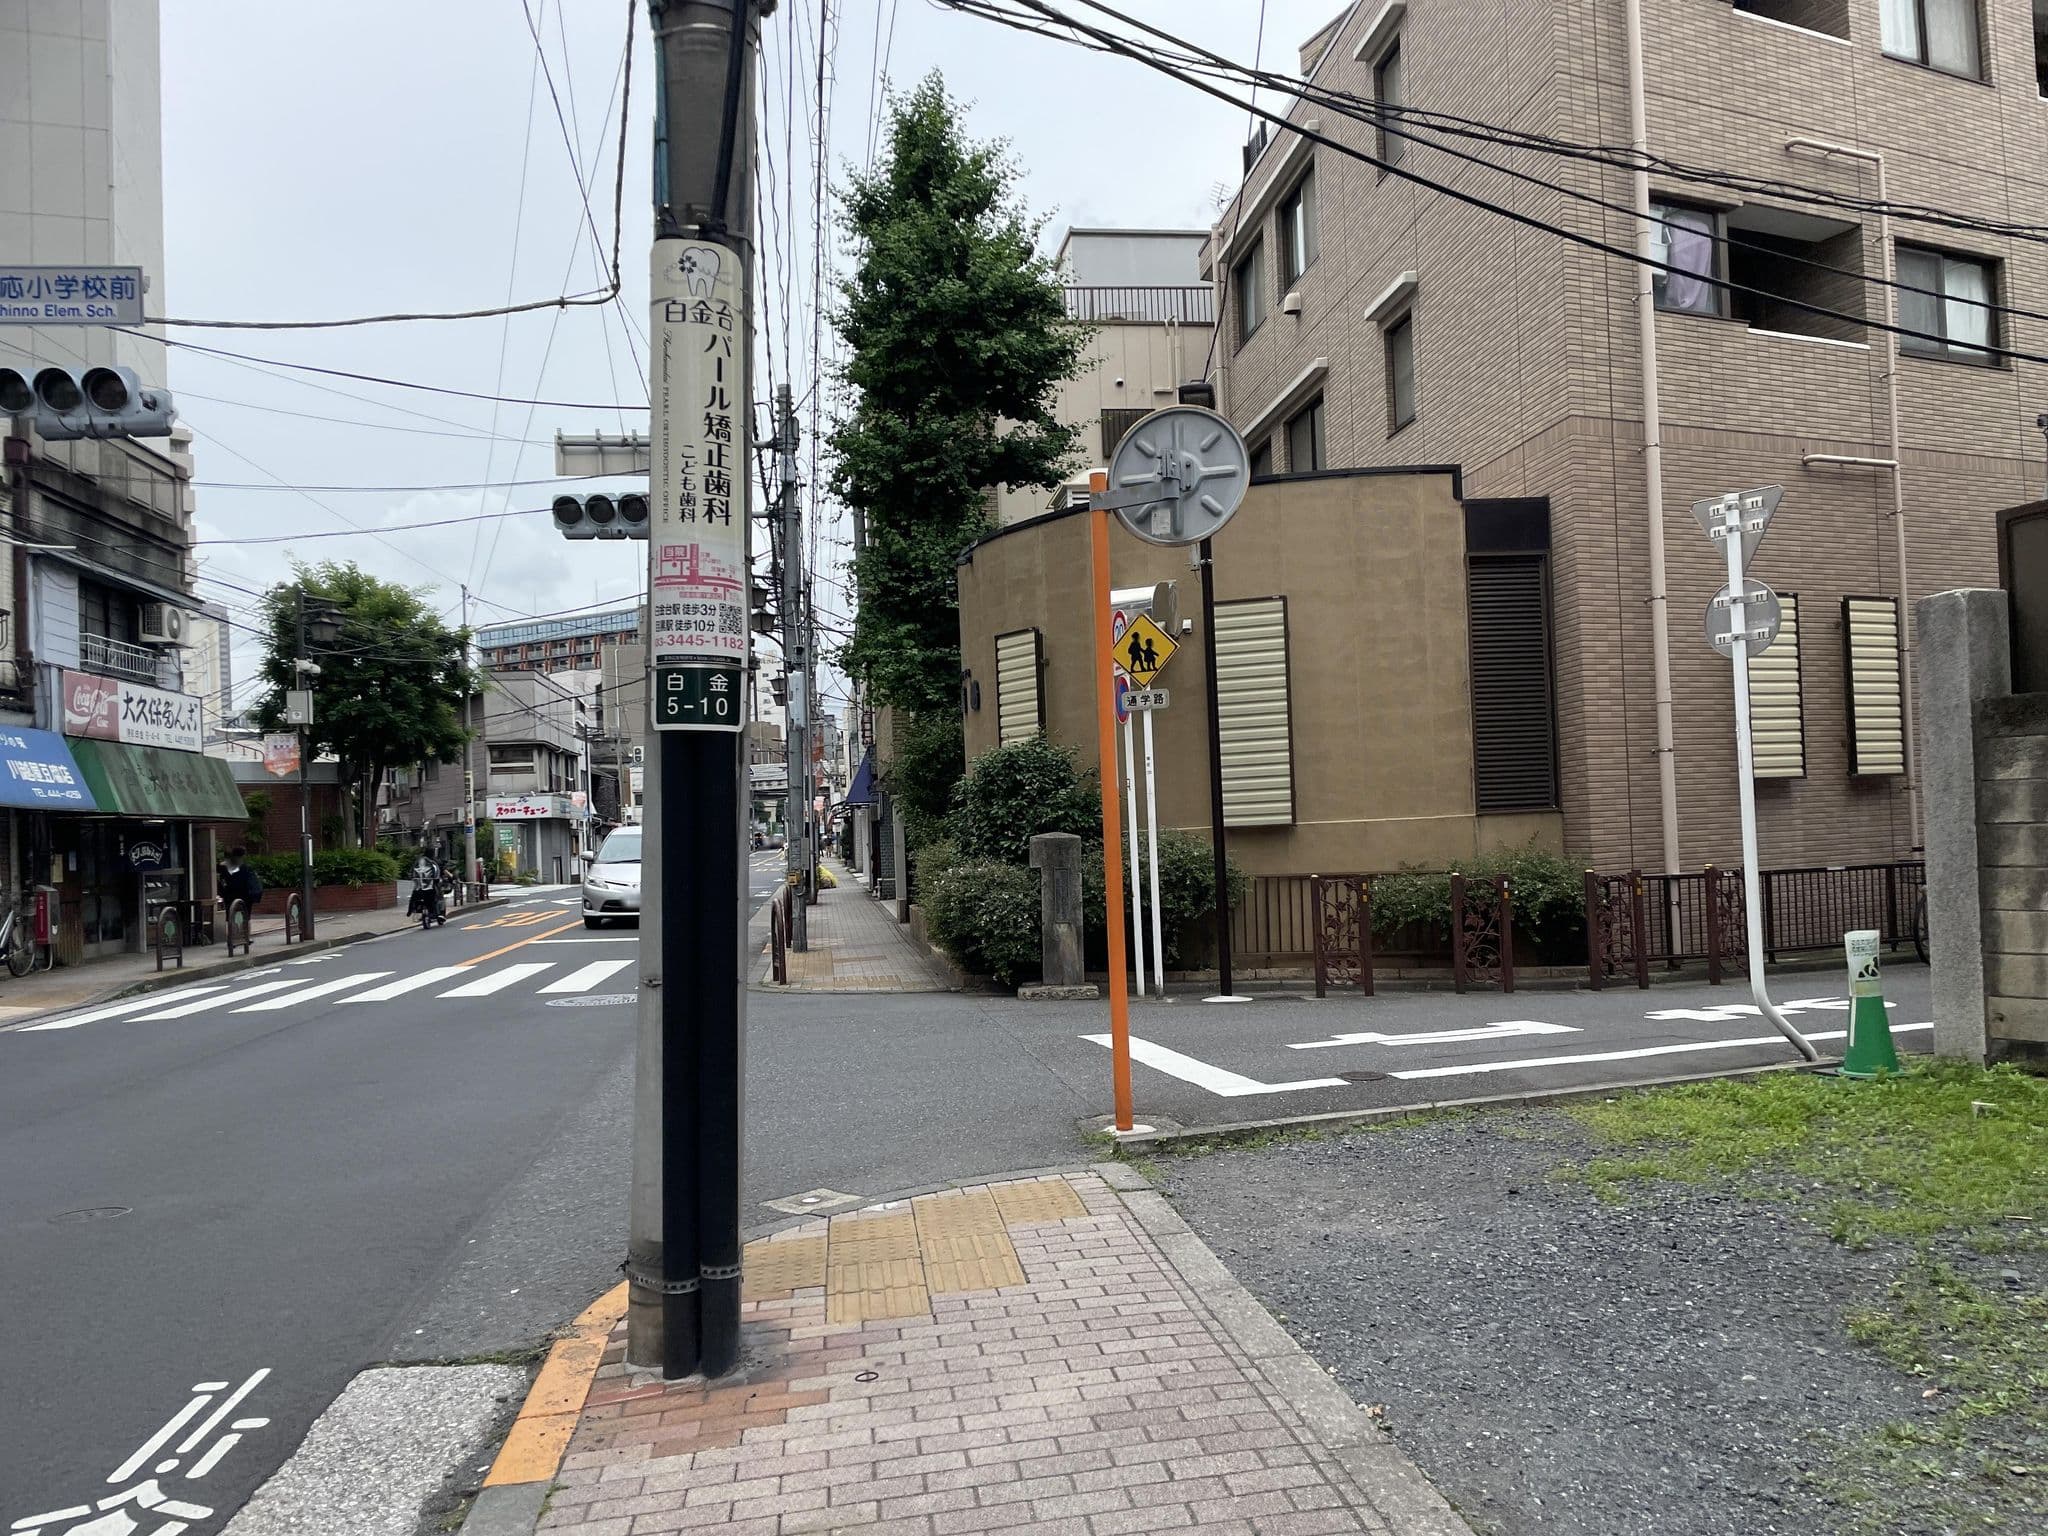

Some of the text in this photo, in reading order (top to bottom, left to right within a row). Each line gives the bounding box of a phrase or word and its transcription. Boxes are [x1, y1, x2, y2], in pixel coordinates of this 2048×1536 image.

[45, 304, 83, 317] Elem.
[86, 304, 117, 317] Sch.
[665, 300, 733, 331] 白金台
[702, 334, 732, 526] パール矯正歯科
[679, 444, 697, 523] こども歯科
[667, 696, 728, 716] 5-10
[1127, 693, 1164, 707] 通学路
